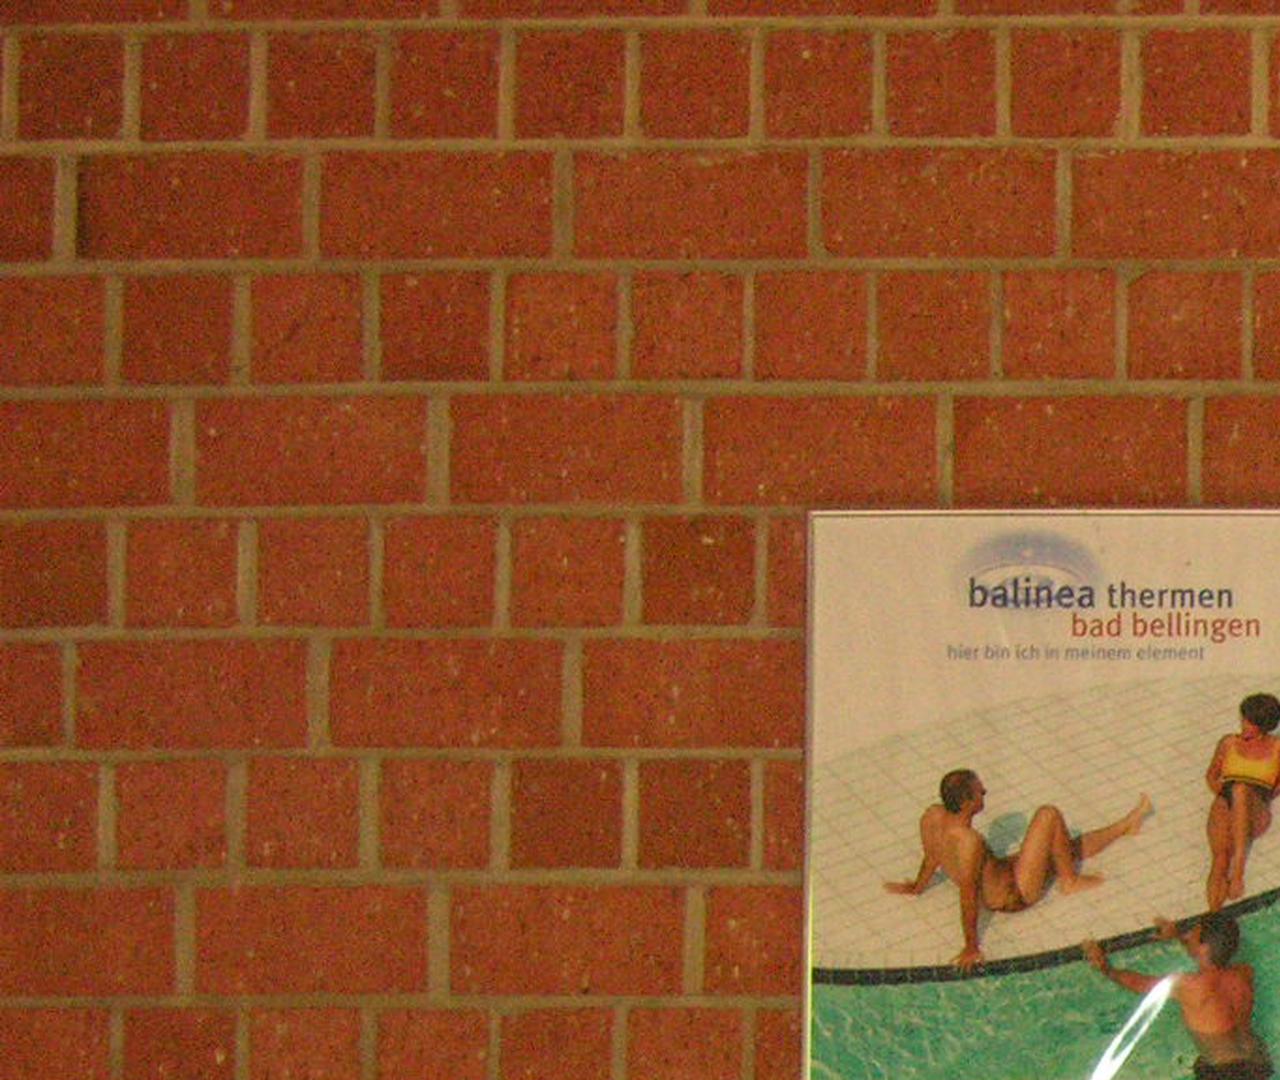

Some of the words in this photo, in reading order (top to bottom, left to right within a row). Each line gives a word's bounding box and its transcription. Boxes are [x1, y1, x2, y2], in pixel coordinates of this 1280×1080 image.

[968, 577, 1095, 608] balinea
[1107, 582, 1234, 608] thermen
[1071, 612, 1122, 638] bad
[1132, 612, 1261, 644] bellingen
[947, 644, 979, 660] hier
[984, 644, 1008, 660] bin
[1014, 644, 1041, 661] ich
[1045, 644, 1060, 660] in
[1064, 644, 1132, 661] meinem
[1136, 645, 1205, 661] element
